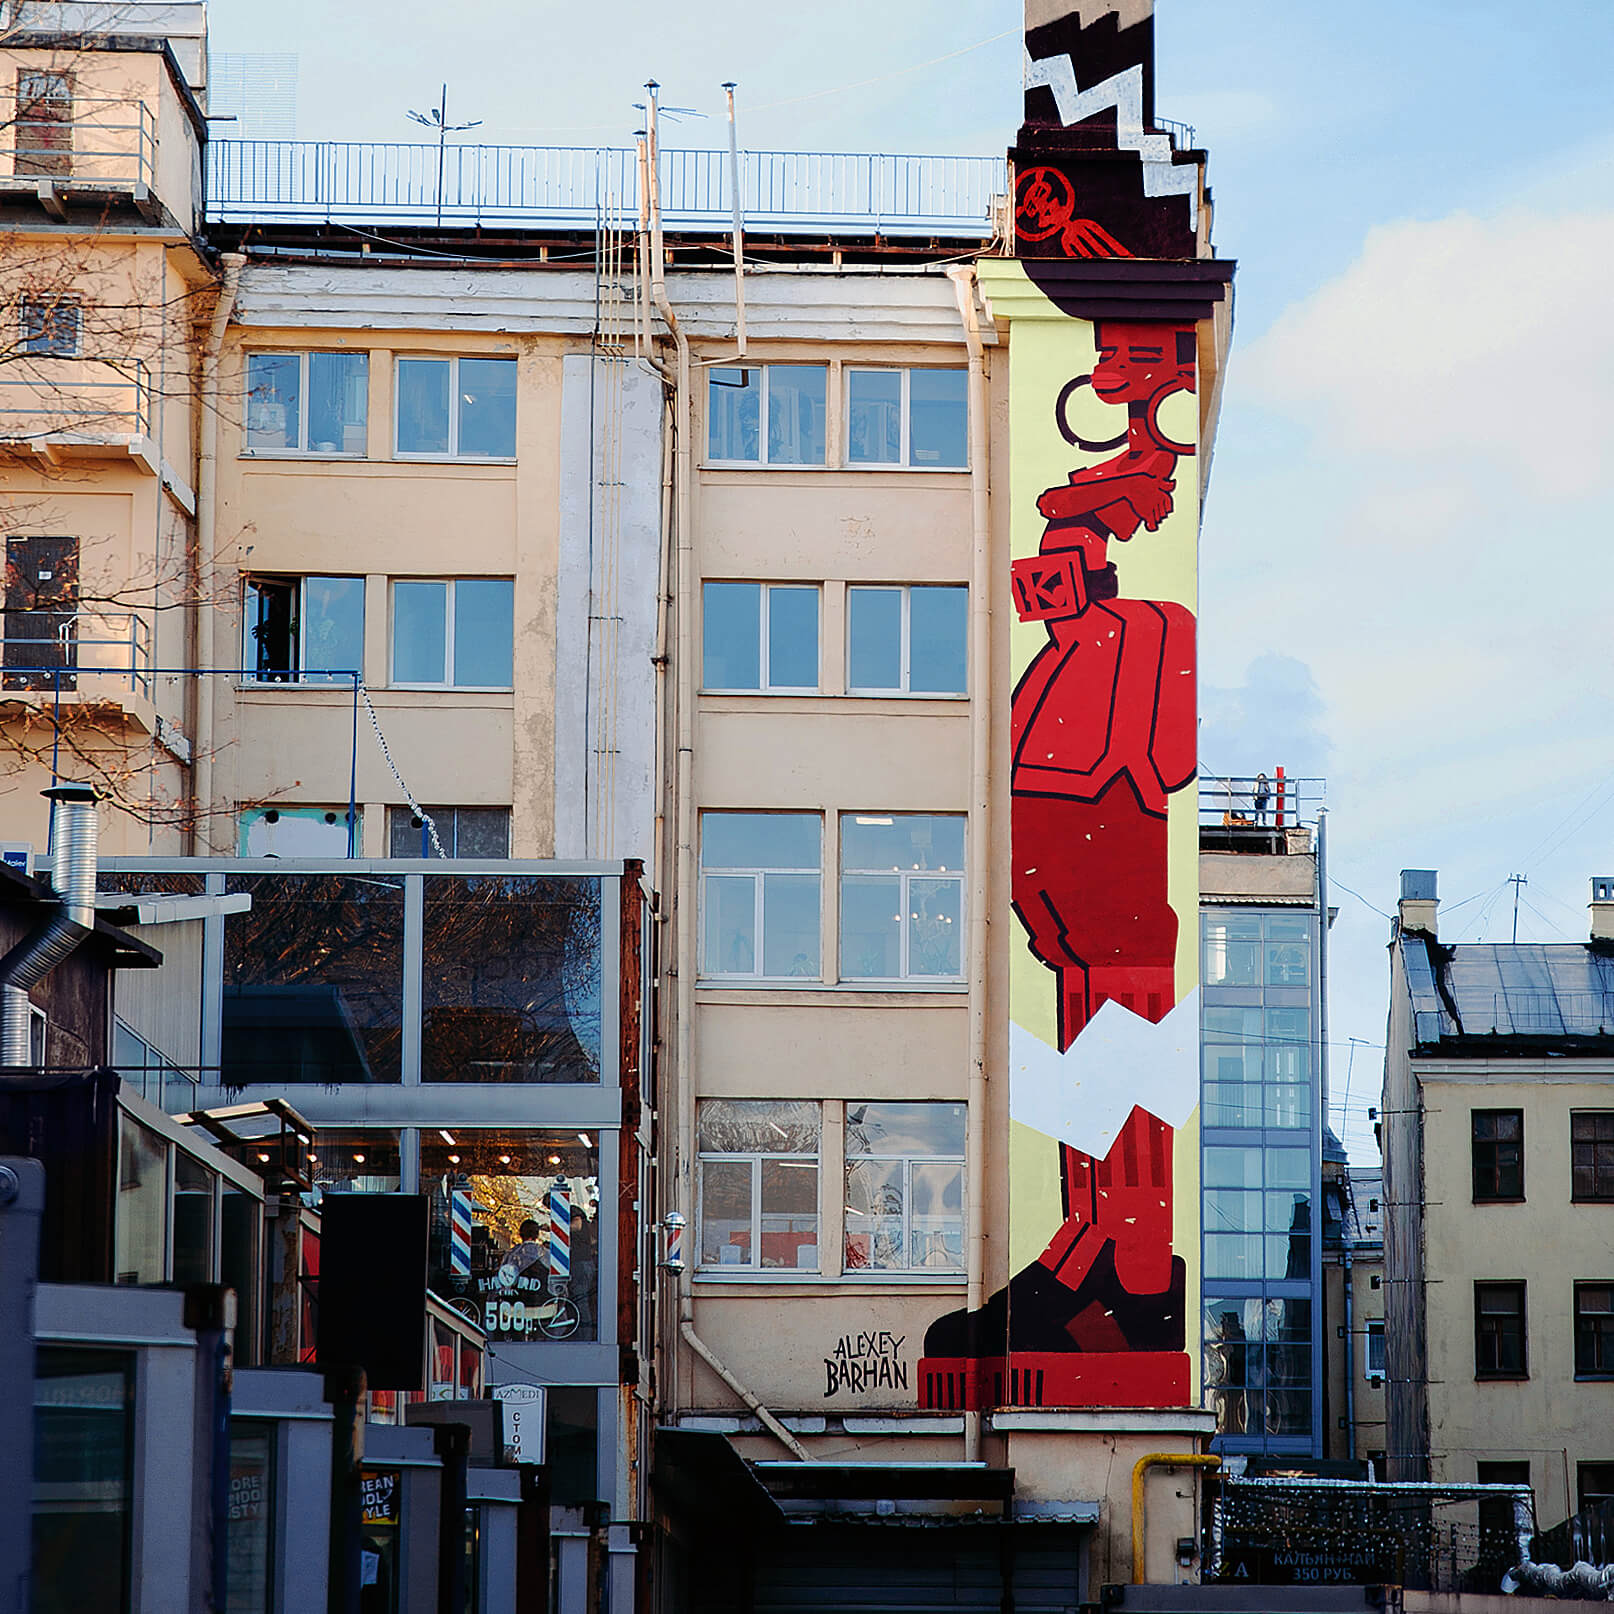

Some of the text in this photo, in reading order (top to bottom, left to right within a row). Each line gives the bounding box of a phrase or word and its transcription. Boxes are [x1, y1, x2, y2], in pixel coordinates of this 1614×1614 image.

[833, 1331, 906, 1360] ALEXEY
[823, 1356, 909, 1398] BARHAN
[1293, 1567, 1320, 1580] 350
